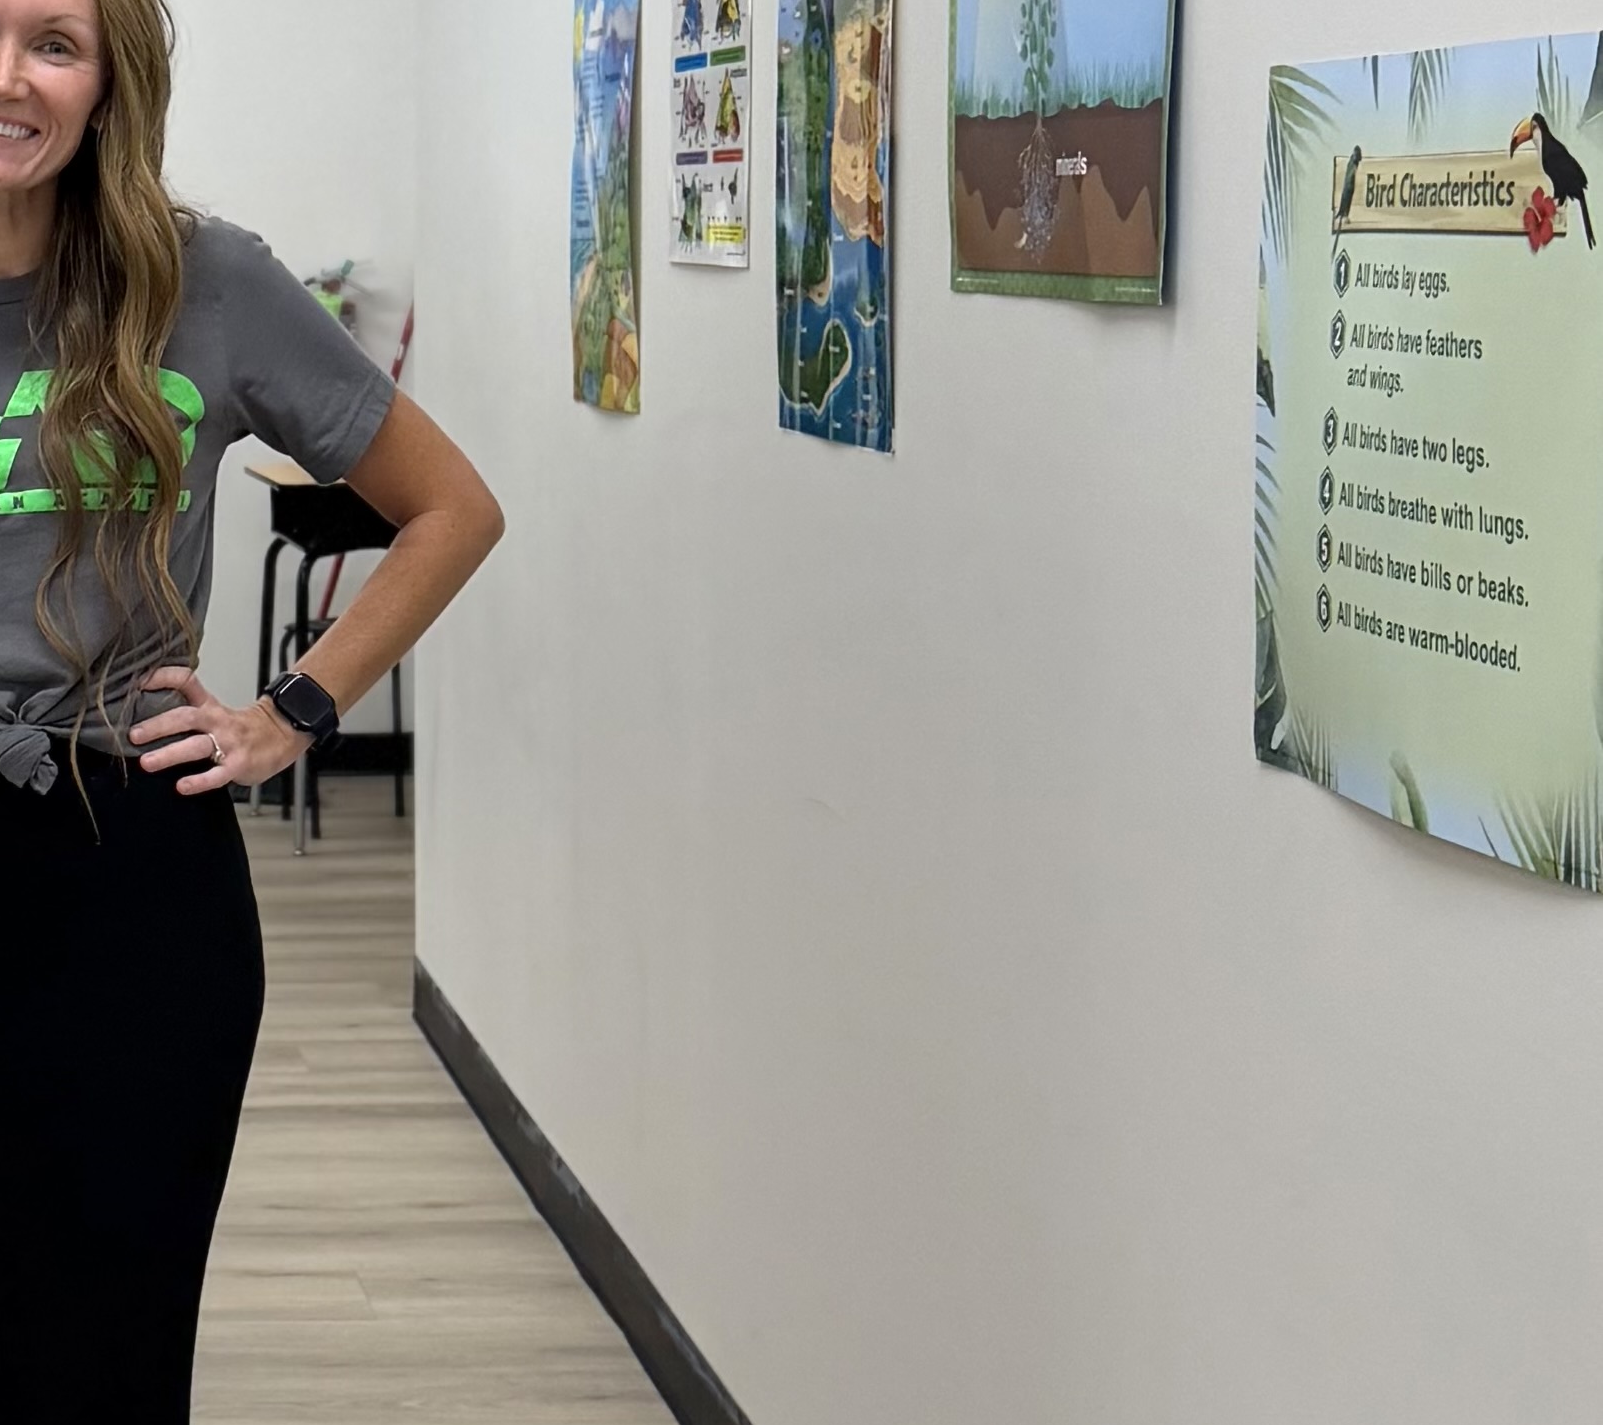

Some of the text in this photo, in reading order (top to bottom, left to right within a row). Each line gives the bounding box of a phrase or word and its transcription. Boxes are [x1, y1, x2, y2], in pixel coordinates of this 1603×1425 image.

[1365, 170, 1515, 208] Bird Characteristics
[1354, 263, 1371, 288] All
[1373, 264, 1399, 290] birds
[1401, 265, 1416, 297] lay
[1419, 271, 1450, 299] eggs.
[1350, 323, 1365, 349] All
[1367, 324, 1394, 352] birds
[1397, 327, 1422, 354] have
[1426, 329, 1483, 359] feathers
[1347, 363, 1404, 398] and wings.
[1342, 421, 1358, 448] All
[1359, 423, 1387, 453] birds
[1390, 429, 1419, 458] have
[1422, 436, 1448, 462] two
[1452, 437, 1490, 473] legs.
[1339, 482, 1354, 508] All
[1357, 484, 1385, 514] birds
[1388, 491, 1437, 525] breathe
[1441, 502, 1473, 531] with
[1479, 506, 1529, 545] lungs.
[1337, 541, 1352, 568] All
[1355, 545, 1383, 576] birds
[1387, 553, 1416, 584] have
[1421, 560, 1451, 592] bills
[1456, 574, 1474, 596] or
[1478, 571, 1529, 608] beaks.
[1337, 601, 1351, 627] All
[1354, 605, 1382, 638] birds
[1385, 620, 1405, 644] are
[1408, 627, 1521, 672] warm-blooded.
